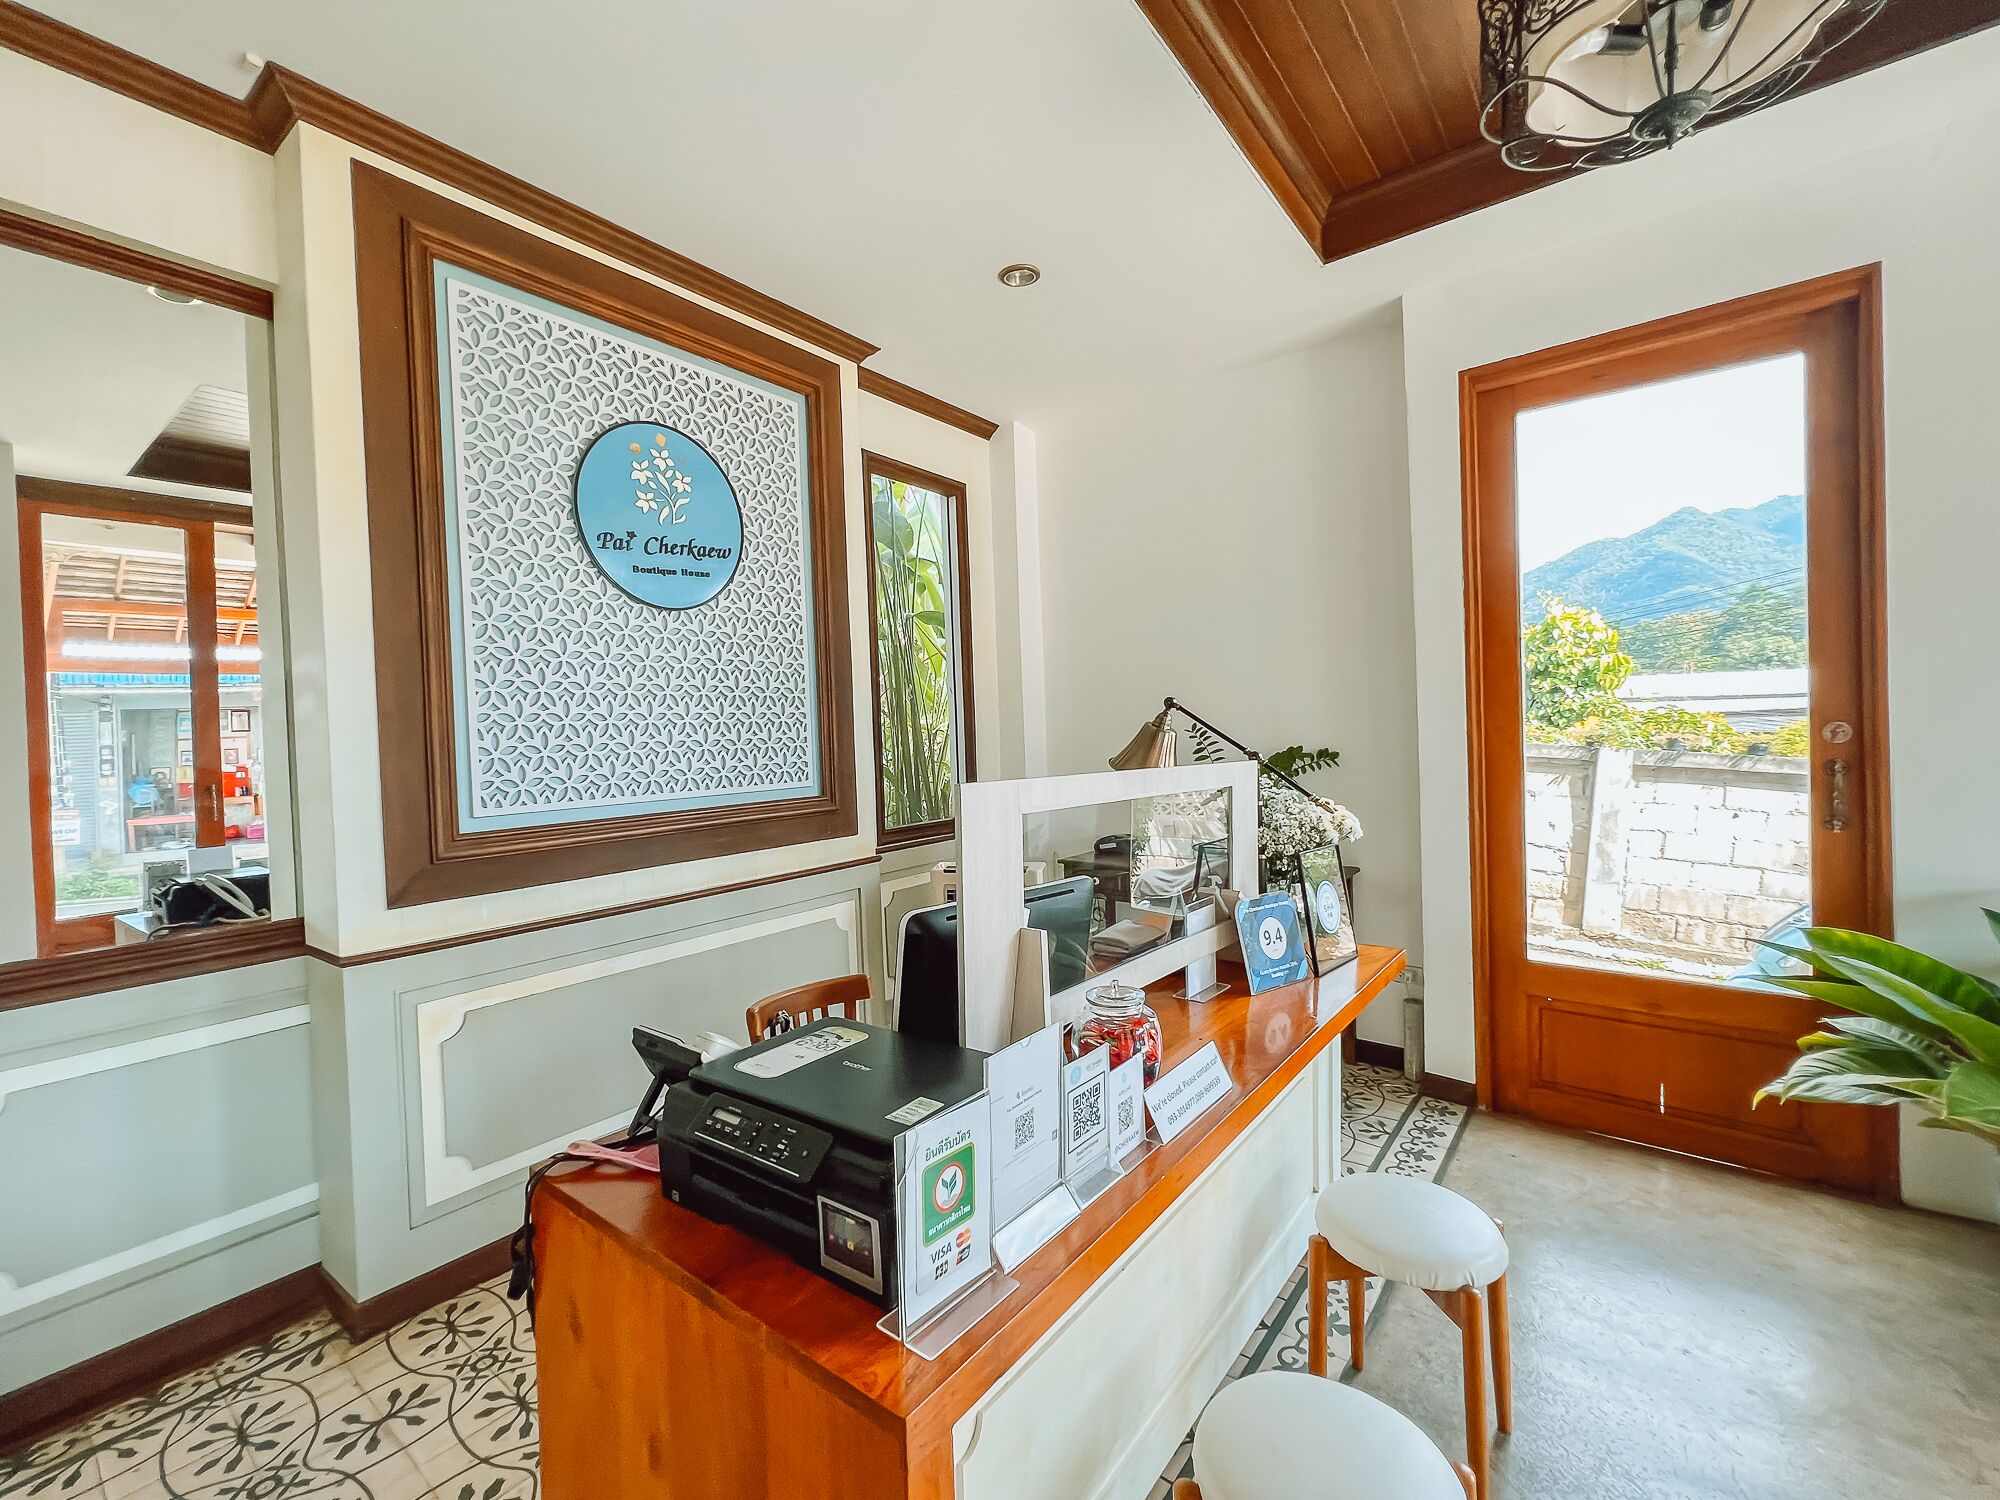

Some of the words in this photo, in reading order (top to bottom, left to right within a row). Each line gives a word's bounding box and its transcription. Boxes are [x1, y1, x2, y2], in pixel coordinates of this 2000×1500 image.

[596, 530, 638, 552] Pai
[643, 535, 732, 561] Cherkaew
[632, 565, 678, 577] Boutique
[680, 568, 711, 578] House
[1263, 927, 1283, 946] 9.4
[1182, 1074, 1197, 1089] Please
[925, 1129, 971, 1162] ยินดีรับบัตร
[931, 1241, 952, 1265] VISA
